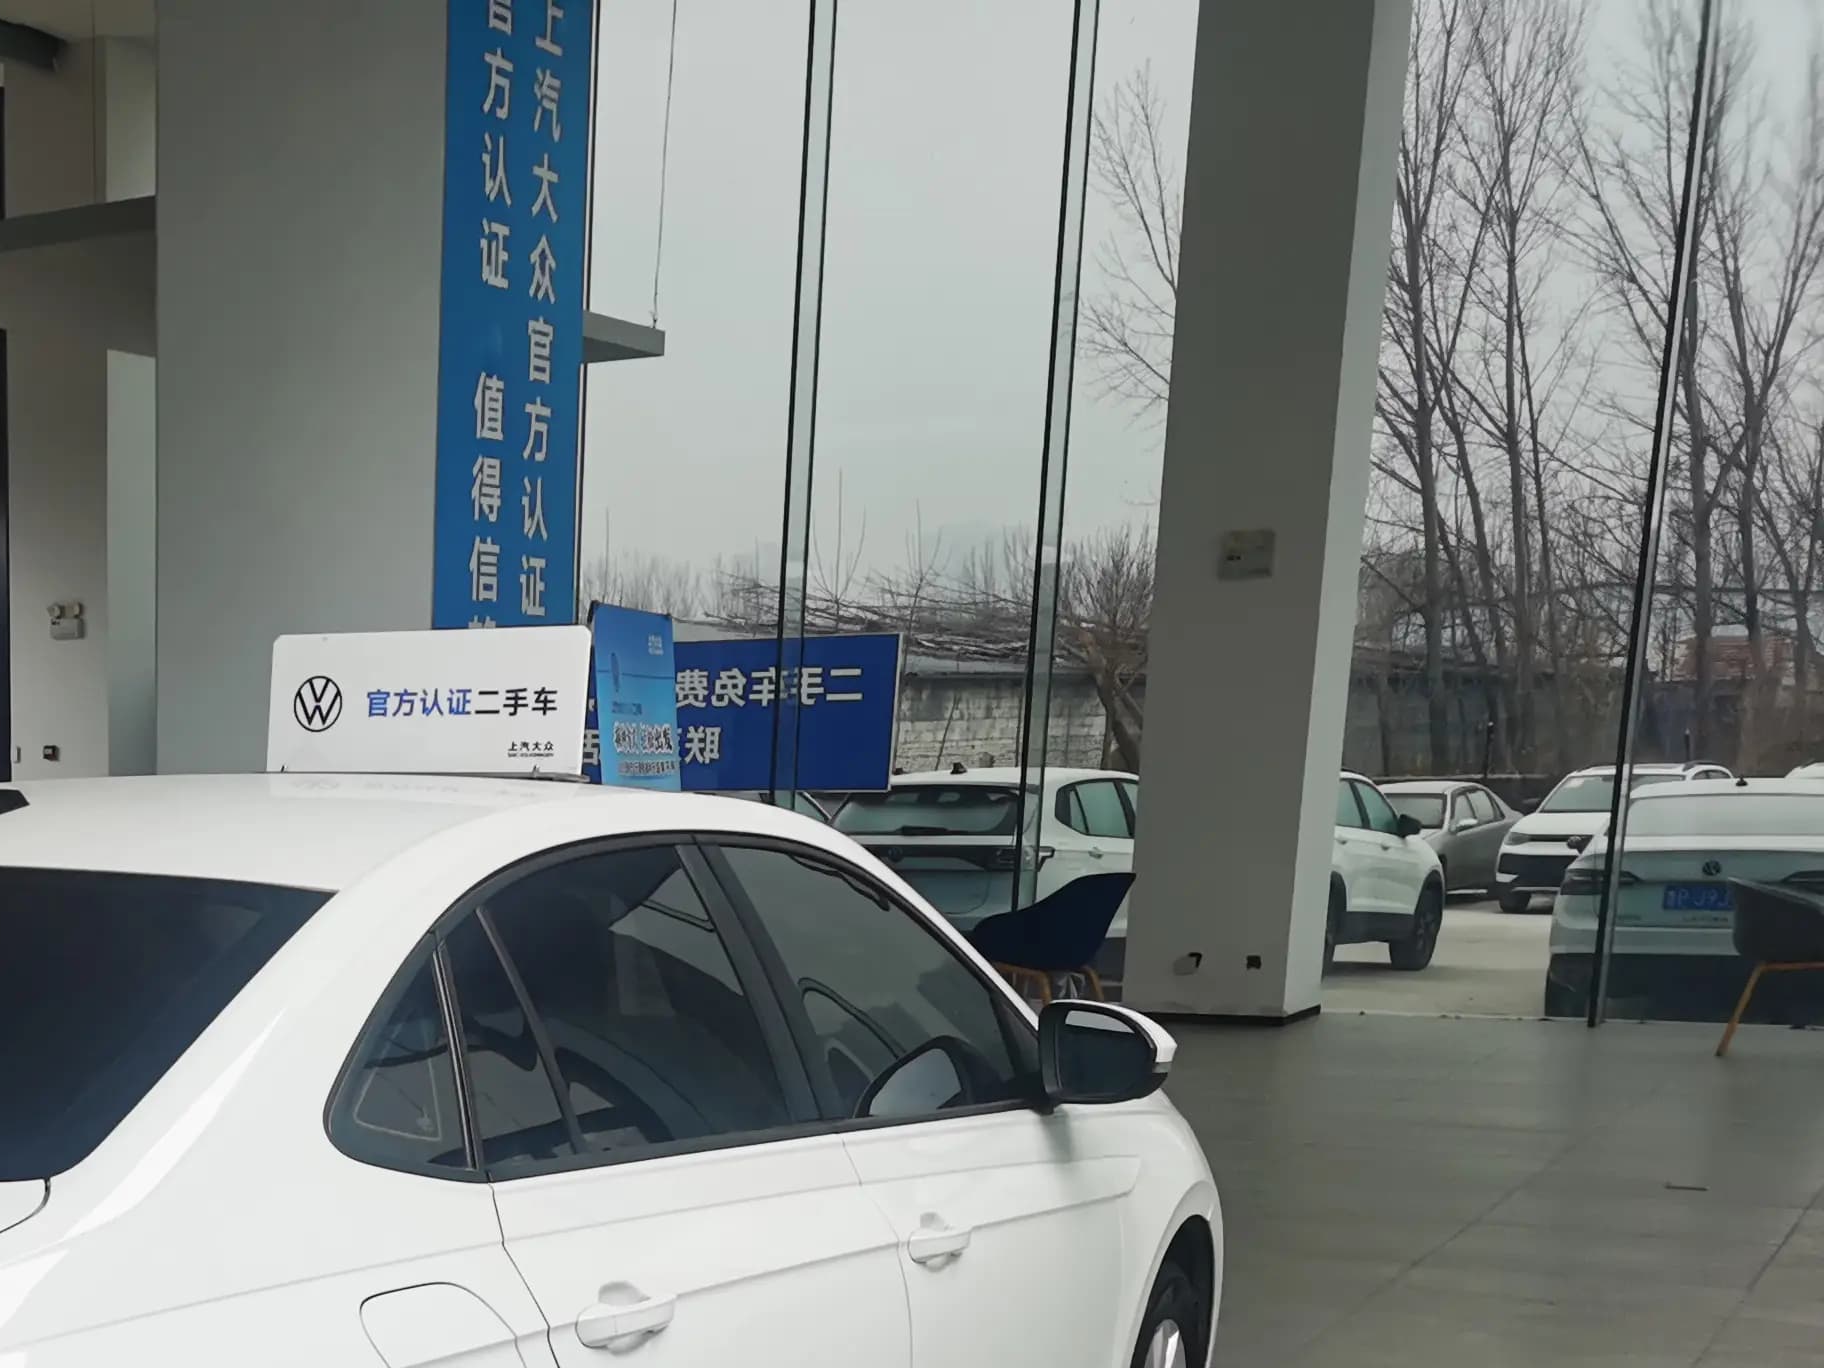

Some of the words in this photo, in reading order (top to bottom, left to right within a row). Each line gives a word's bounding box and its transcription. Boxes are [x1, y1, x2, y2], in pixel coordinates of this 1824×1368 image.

[519, 0, 565, 617] 上汽大众官方认证
[468, 371, 506, 629] 值得信
[366, 686, 558, 719] 官方认证二手车
[507, 740, 555, 752] 上汽大众
